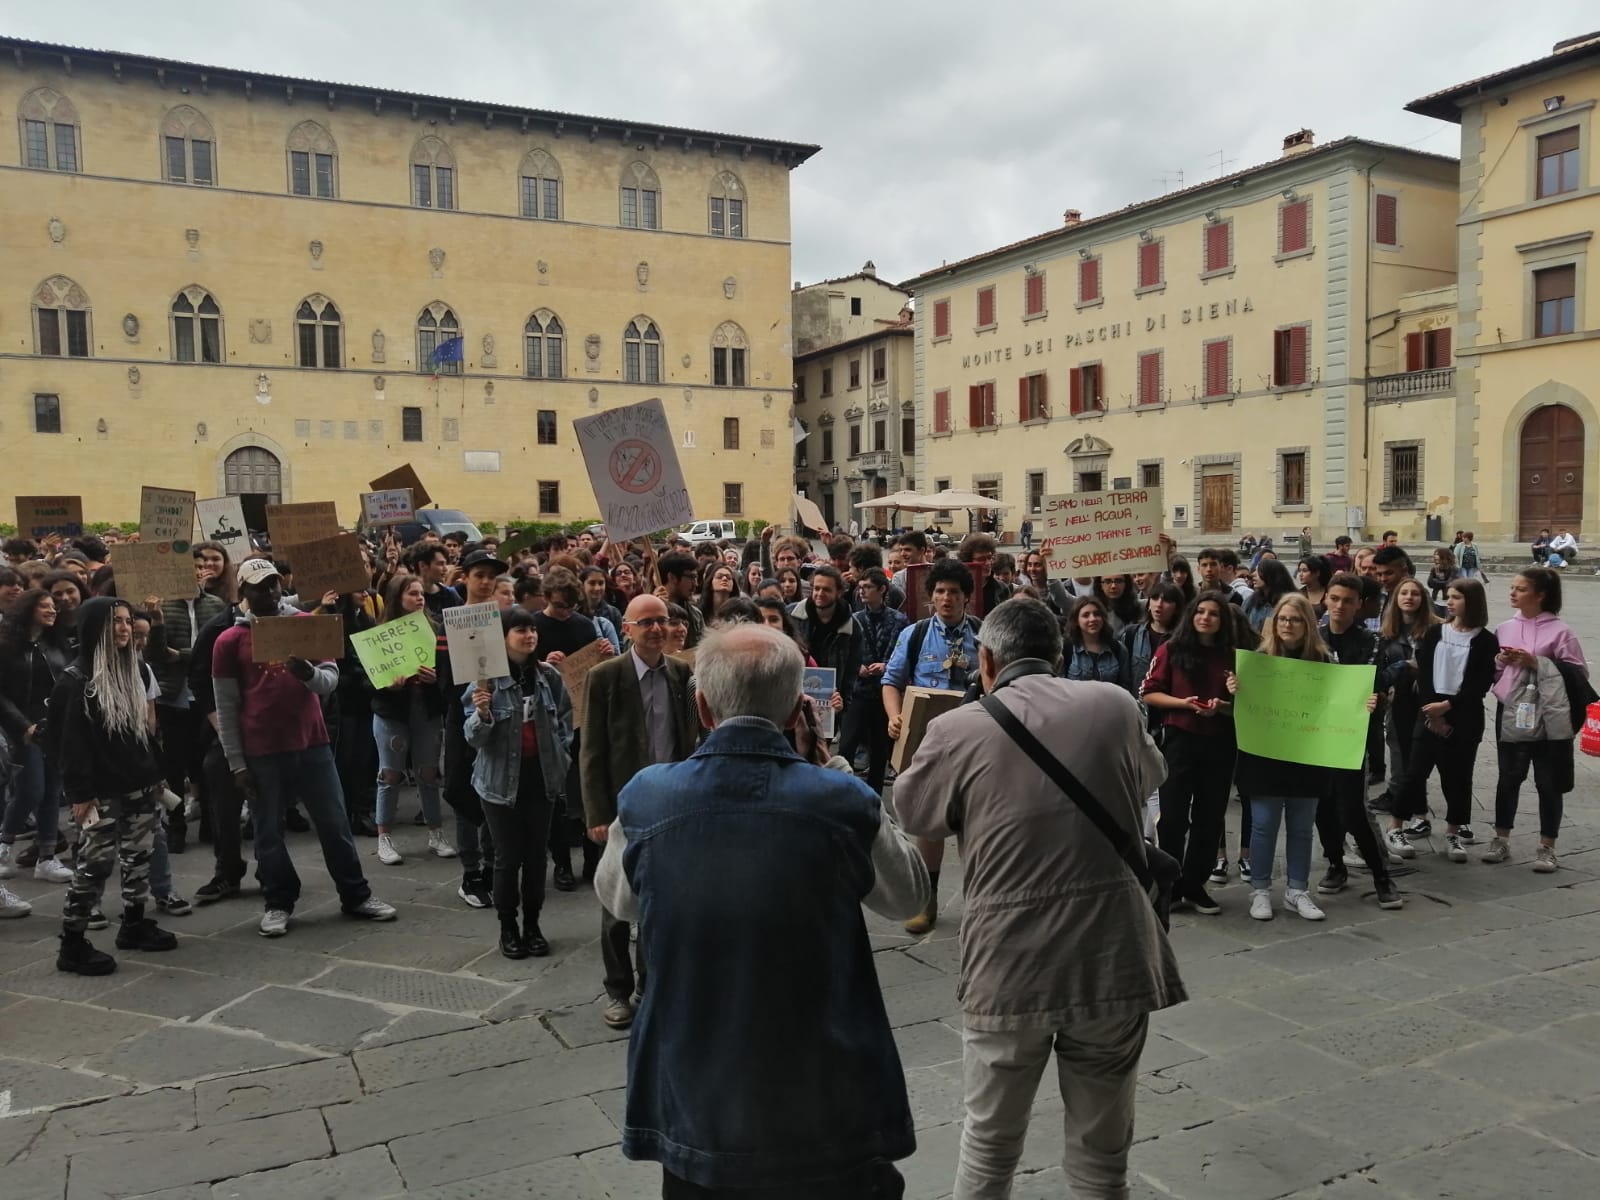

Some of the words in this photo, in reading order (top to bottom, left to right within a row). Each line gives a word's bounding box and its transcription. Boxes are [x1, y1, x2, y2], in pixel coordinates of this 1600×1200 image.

[962, 347, 1012, 369] MONTE
[1024, 338, 1053, 356] DEI
[1065, 320, 1131, 348] PASCHI
[1145, 313, 1166, 332] DI
[1182, 296, 1254, 324] SIENA
[1046, 499, 1078, 512] SIAMO
[1082, 497, 1103, 507] NELLA
[1107, 490, 1148, 505] TERRA
[1048, 533, 1092, 547] NESSUNO
[1137, 525, 1153, 536] TE
[1072, 551, 1112, 569] SALVARTI
[1119, 543, 1161, 560] SALVARLA
[361, 620, 420, 648] THERE'S
[369, 655, 407, 677] PLANET
[414, 646, 429, 663] B
[381, 642, 404, 656] NO
